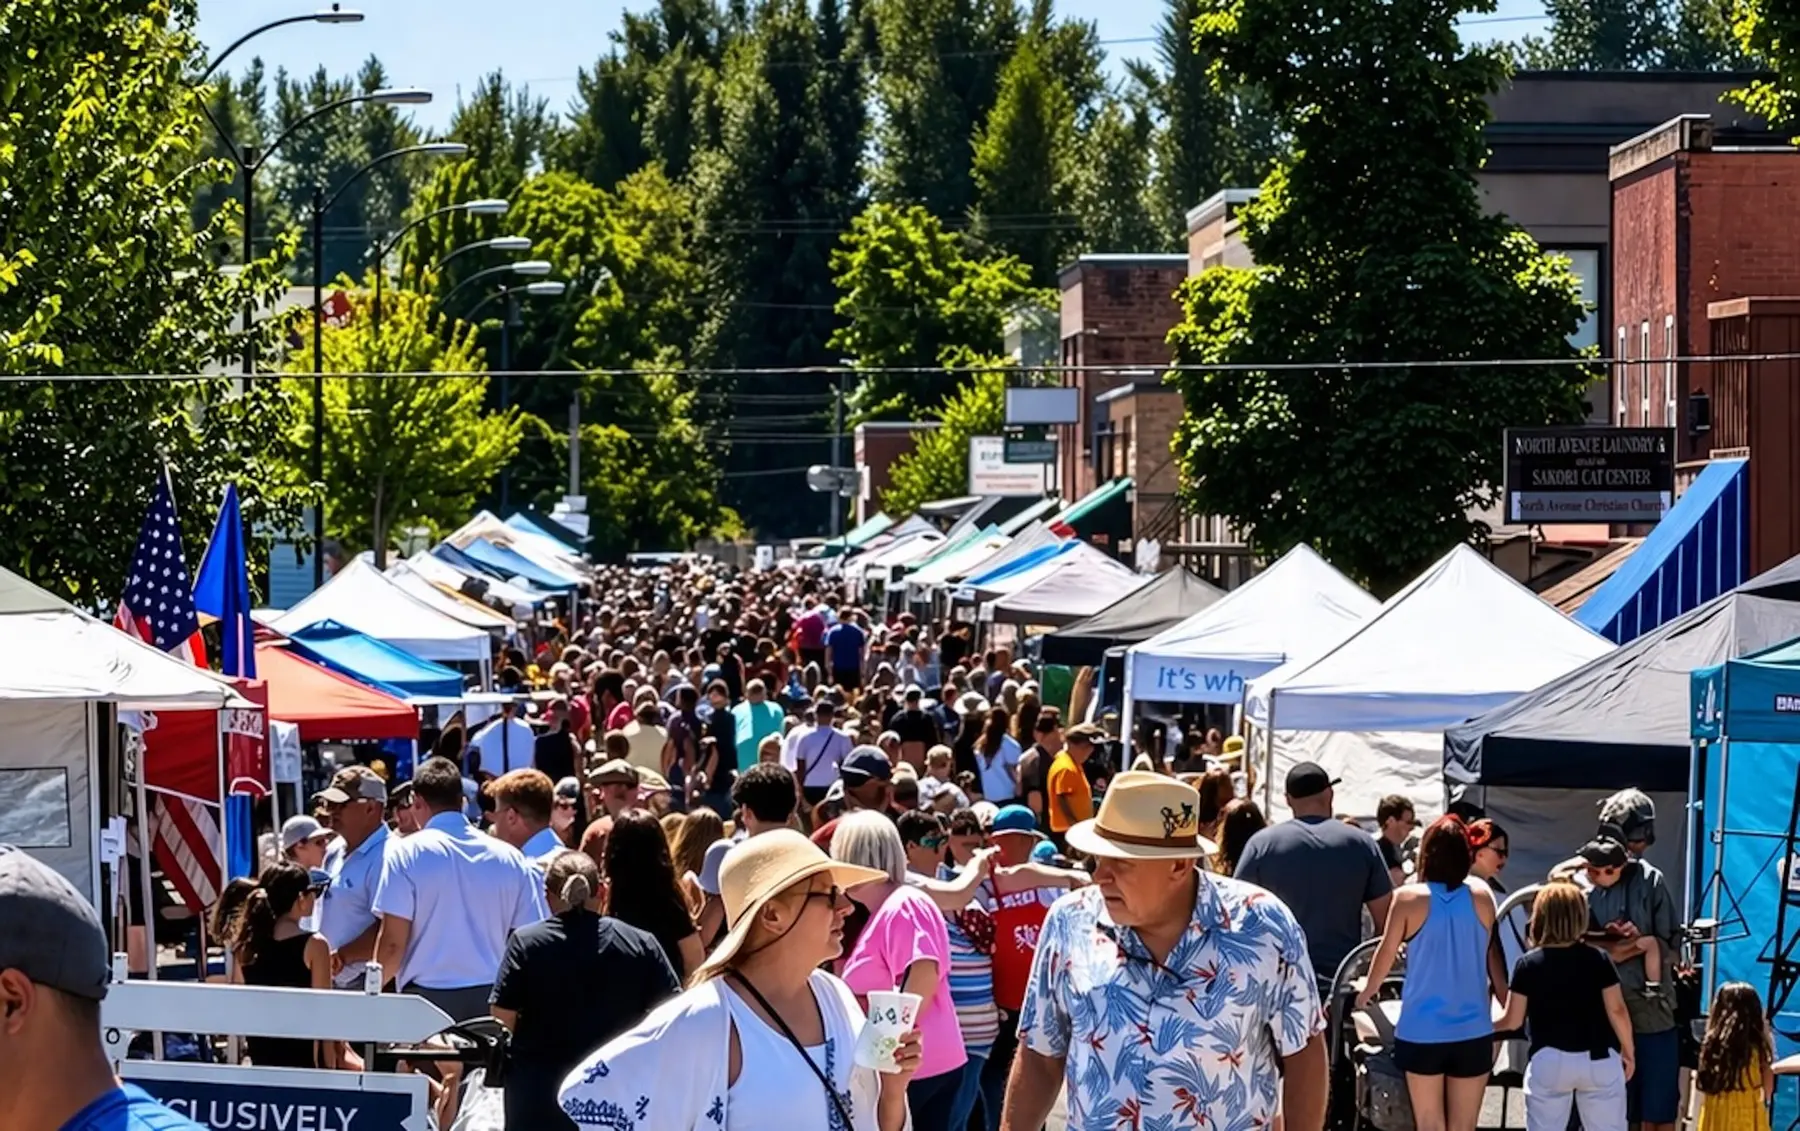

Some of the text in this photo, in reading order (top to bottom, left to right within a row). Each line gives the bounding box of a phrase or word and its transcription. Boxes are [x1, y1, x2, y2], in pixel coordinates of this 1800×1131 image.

[1515, 436, 1556, 455] NORTH
[1602, 435, 1655, 454] LAUNDRY
[1581, 468, 1605, 486] CAT
[1605, 468, 1652, 486] CENTER
[1158, 666, 1249, 692] It's wh
[159, 1098, 358, 1131] LUSIVELY
